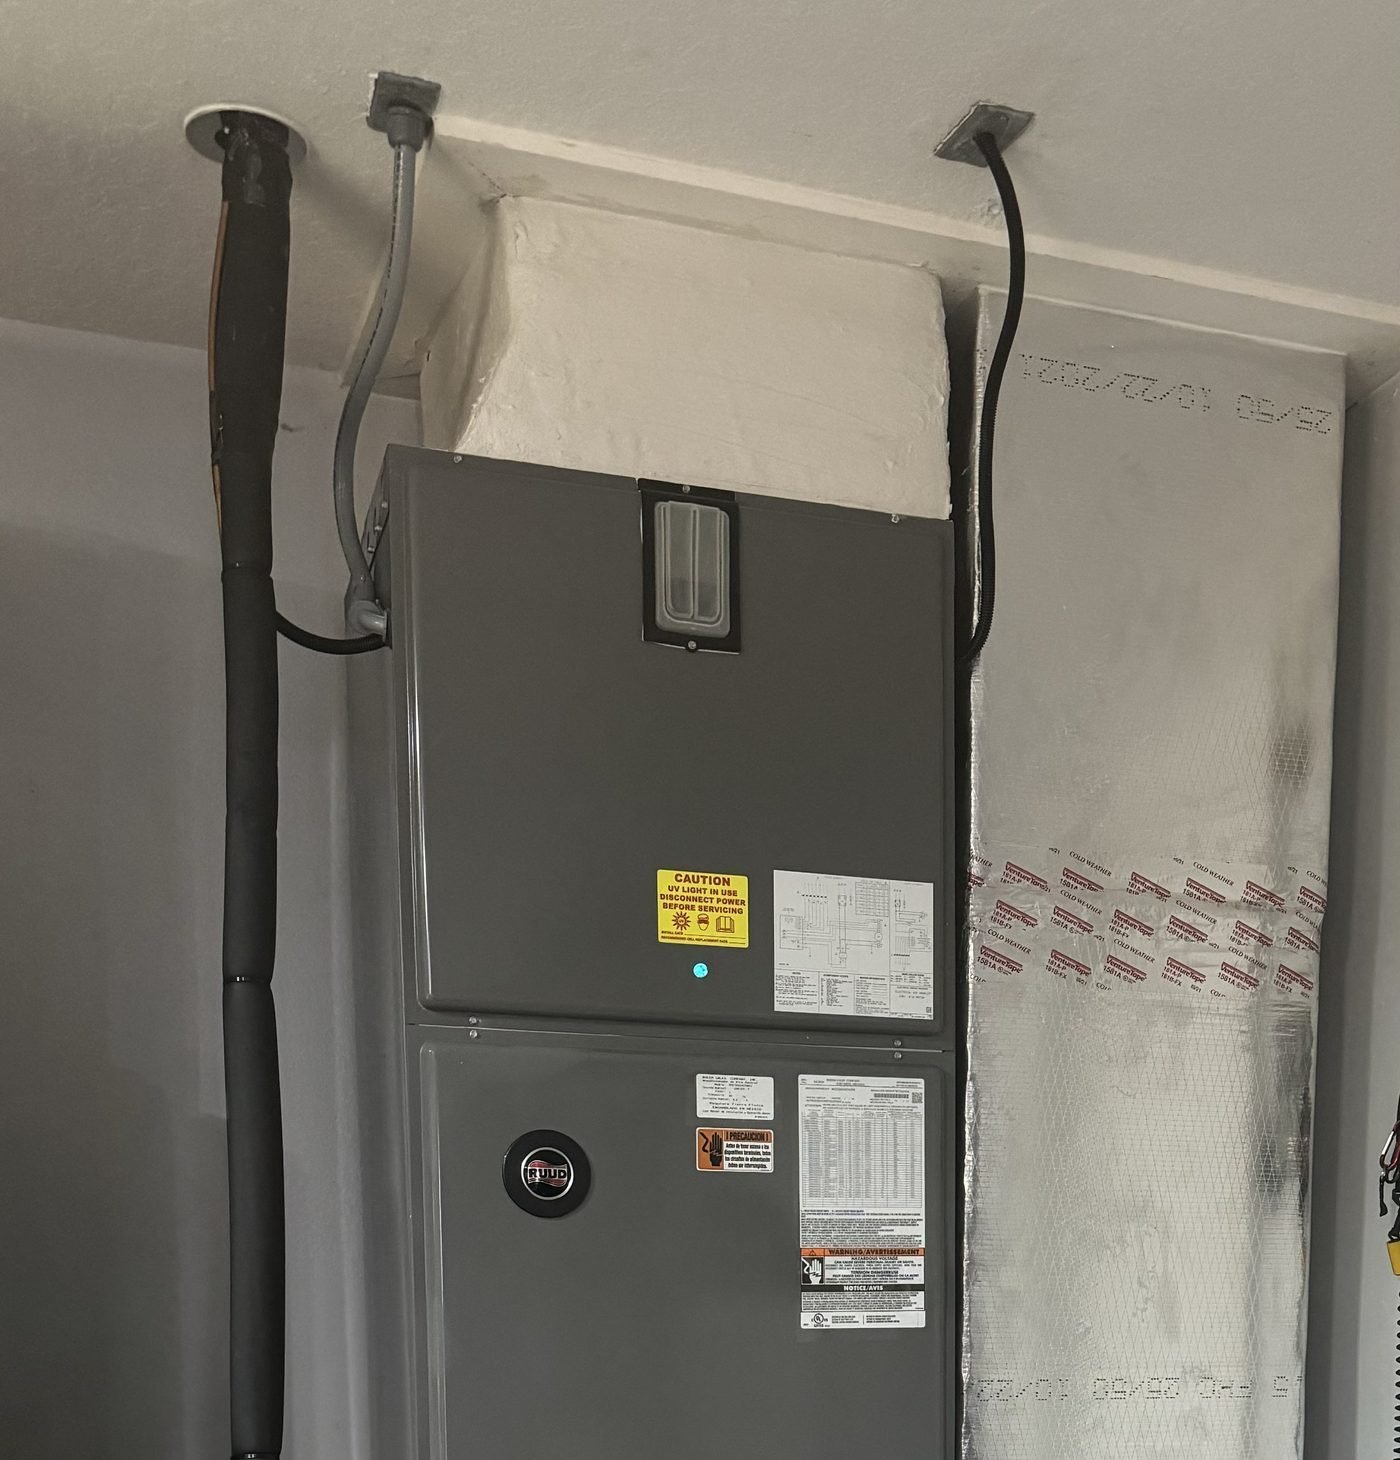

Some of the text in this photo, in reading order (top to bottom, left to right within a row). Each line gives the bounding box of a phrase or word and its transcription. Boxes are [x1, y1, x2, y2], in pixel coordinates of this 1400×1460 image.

[1019, 352, 1332, 434] 25/50 10/22/2021
[1069, 851, 1085, 863] COLD
[1086, 860, 1112, 877] WEATHER
[1193, 861, 1208, 873] COLD
[1209, 869, 1234, 886] WEATHER
[675, 873, 731, 887] CAUTION
[682, 886, 708, 895] LIGHT
[660, 893, 746, 906] DISCONNECT POWER
[662, 902, 744, 915] BEFORE SERVICING
[1053, 907, 1094, 934] VentureTape
[1114, 911, 1154, 937] VentureTape
[1169, 917, 1208, 943] VentureTape
[987, 928, 1032, 955] COLD WEATHER
[977, 956, 996, 971] 1581A
[980, 948, 1023, 974] VentureTape
[1050, 951, 1092, 977] VentureTape
[1103, 965, 1121, 979] 1581A
[1106, 956, 1147, 982] VentureTape
[1166, 959, 1206, 984] VentureTape
[1217, 972, 1235, 986] 1581A
[529, 1168, 567, 1179] RUUD
[1092, 1376, 1180, 1400] 25/50
